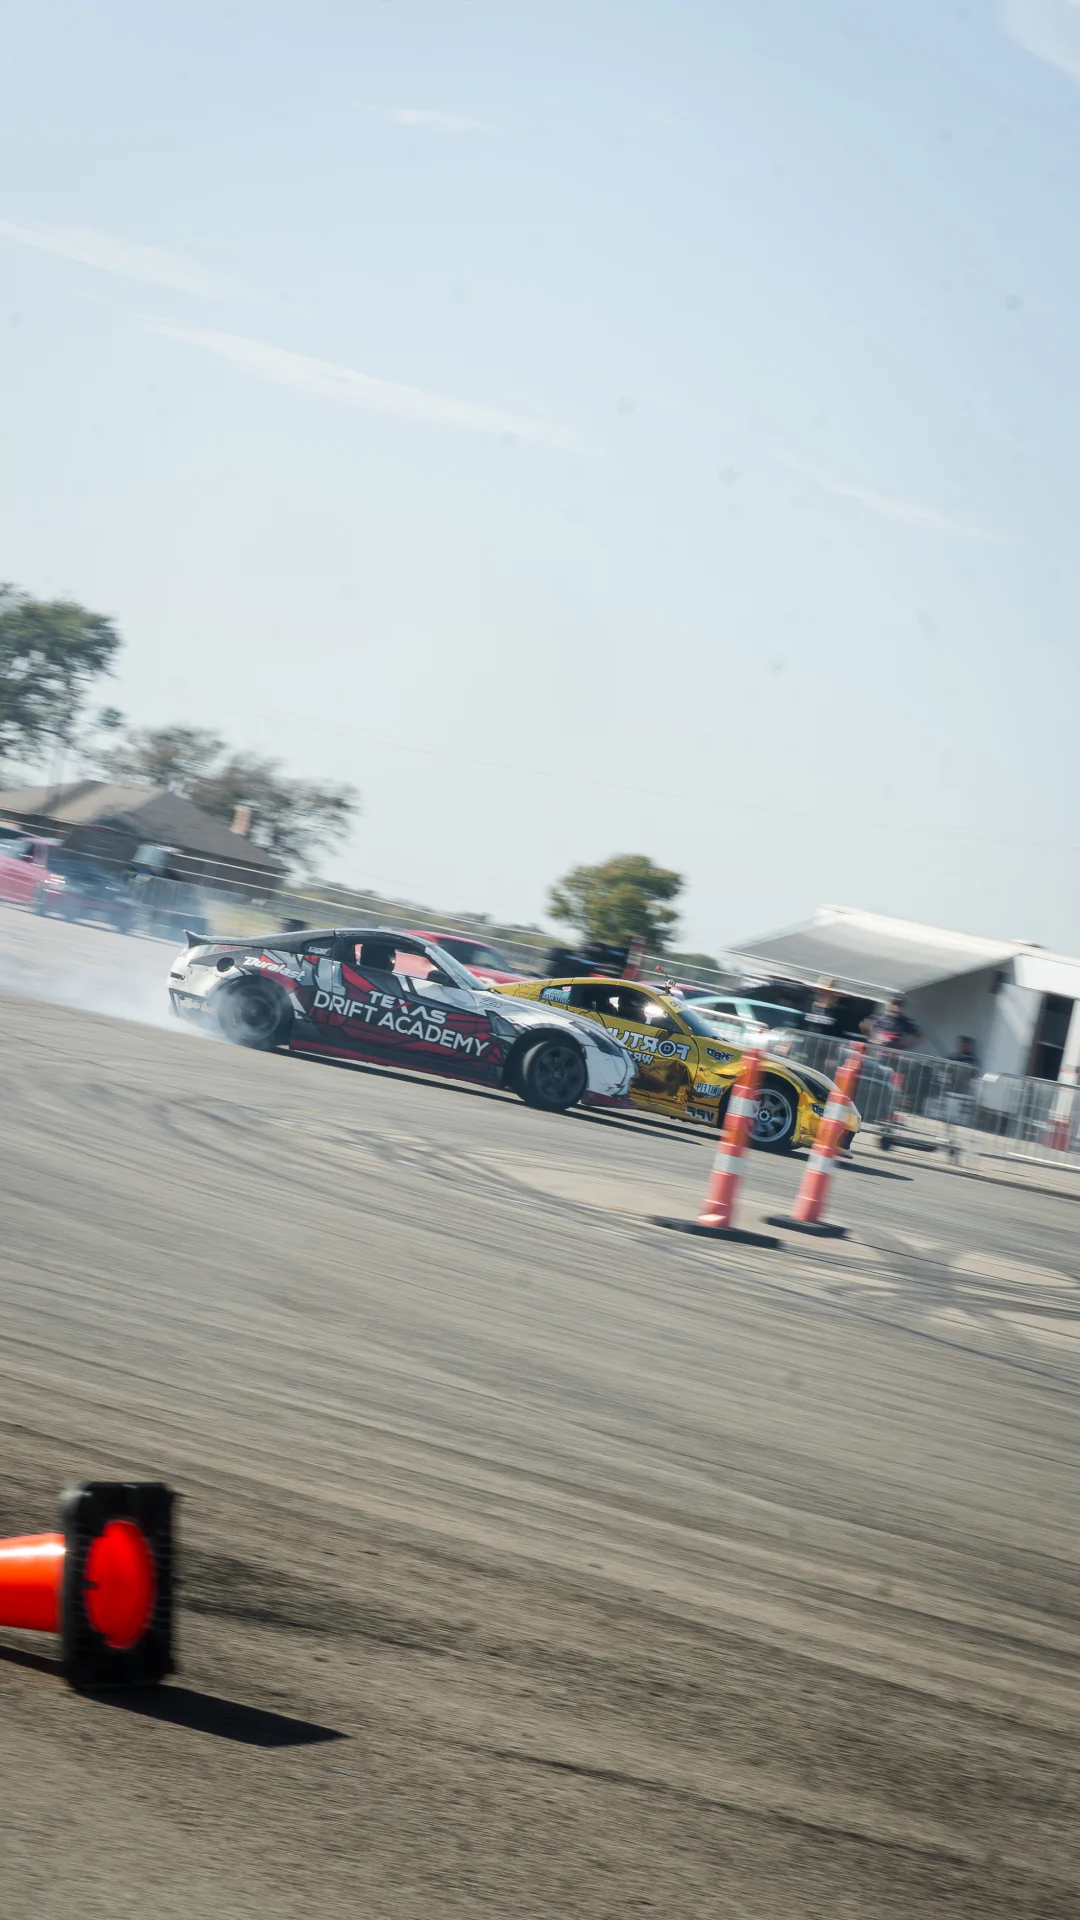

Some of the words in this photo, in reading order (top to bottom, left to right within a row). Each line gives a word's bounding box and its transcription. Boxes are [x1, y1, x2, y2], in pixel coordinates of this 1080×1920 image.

[243, 956, 306, 982] Duralast
[313, 990, 378, 1023] DRIFT
[377, 1012, 490, 1057] ACADEMY
[368, 990, 448, 1025] TEXAS
